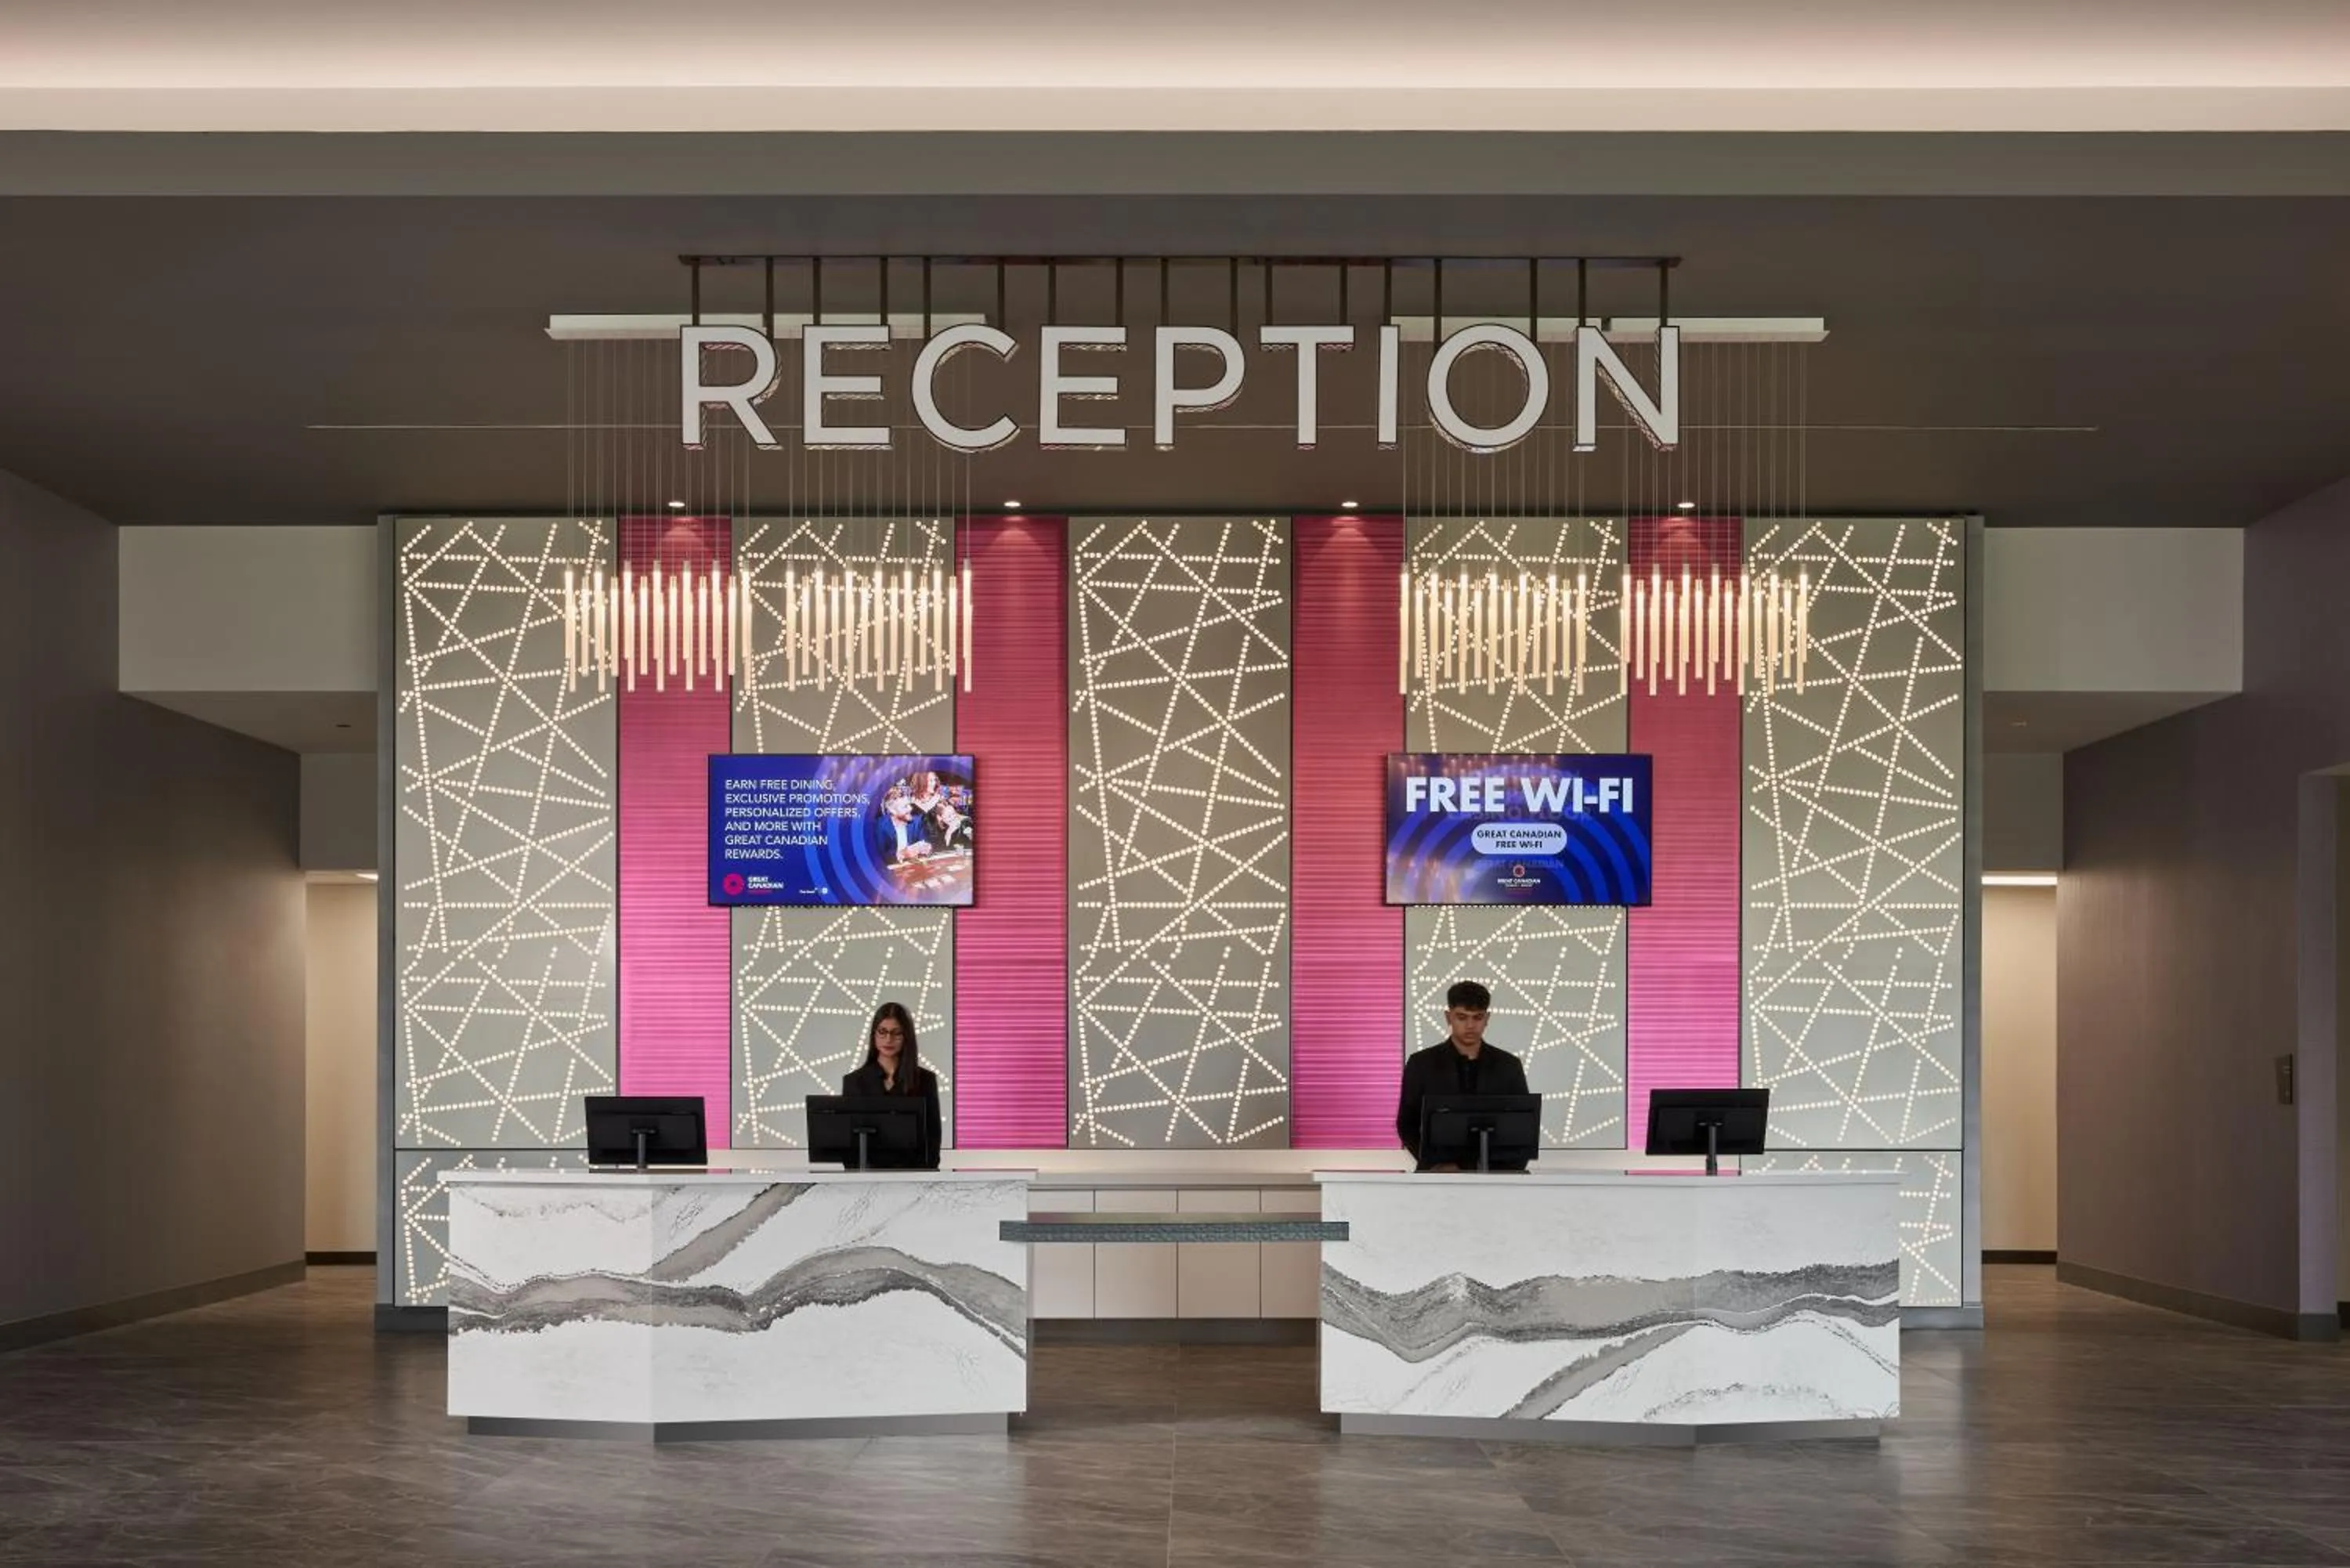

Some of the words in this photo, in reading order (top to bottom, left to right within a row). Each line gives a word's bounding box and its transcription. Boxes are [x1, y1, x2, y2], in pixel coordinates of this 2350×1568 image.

[679, 323, 1681, 452] RECEPTION
[725, 780, 757, 790] EARN
[760, 780, 787, 790] FREE
[725, 794, 786, 804] EXCLUSIVE
[789, 794, 870, 804] PROMOTIONS,
[1406, 776, 1505, 812] FREE
[1520, 777, 1633, 813] WI-FI
[725, 807, 811, 818] PERSONALIZED
[814, 807, 861, 818] OFFERS,
[725, 822, 751, 832] AND
[754, 822, 788, 832] MORE
[791, 822, 822, 832] WITH
[1477, 829, 1507, 839] GREAT
[1509, 829, 1562, 839] CANADIAN
[725, 835, 762, 845] GREAT
[765, 835, 828, 845] CANADIAN
[1495, 840, 1517, 849] FREE
[1519, 840, 1543, 849] WI-FI
[725, 849, 783, 859] REWARDS.
